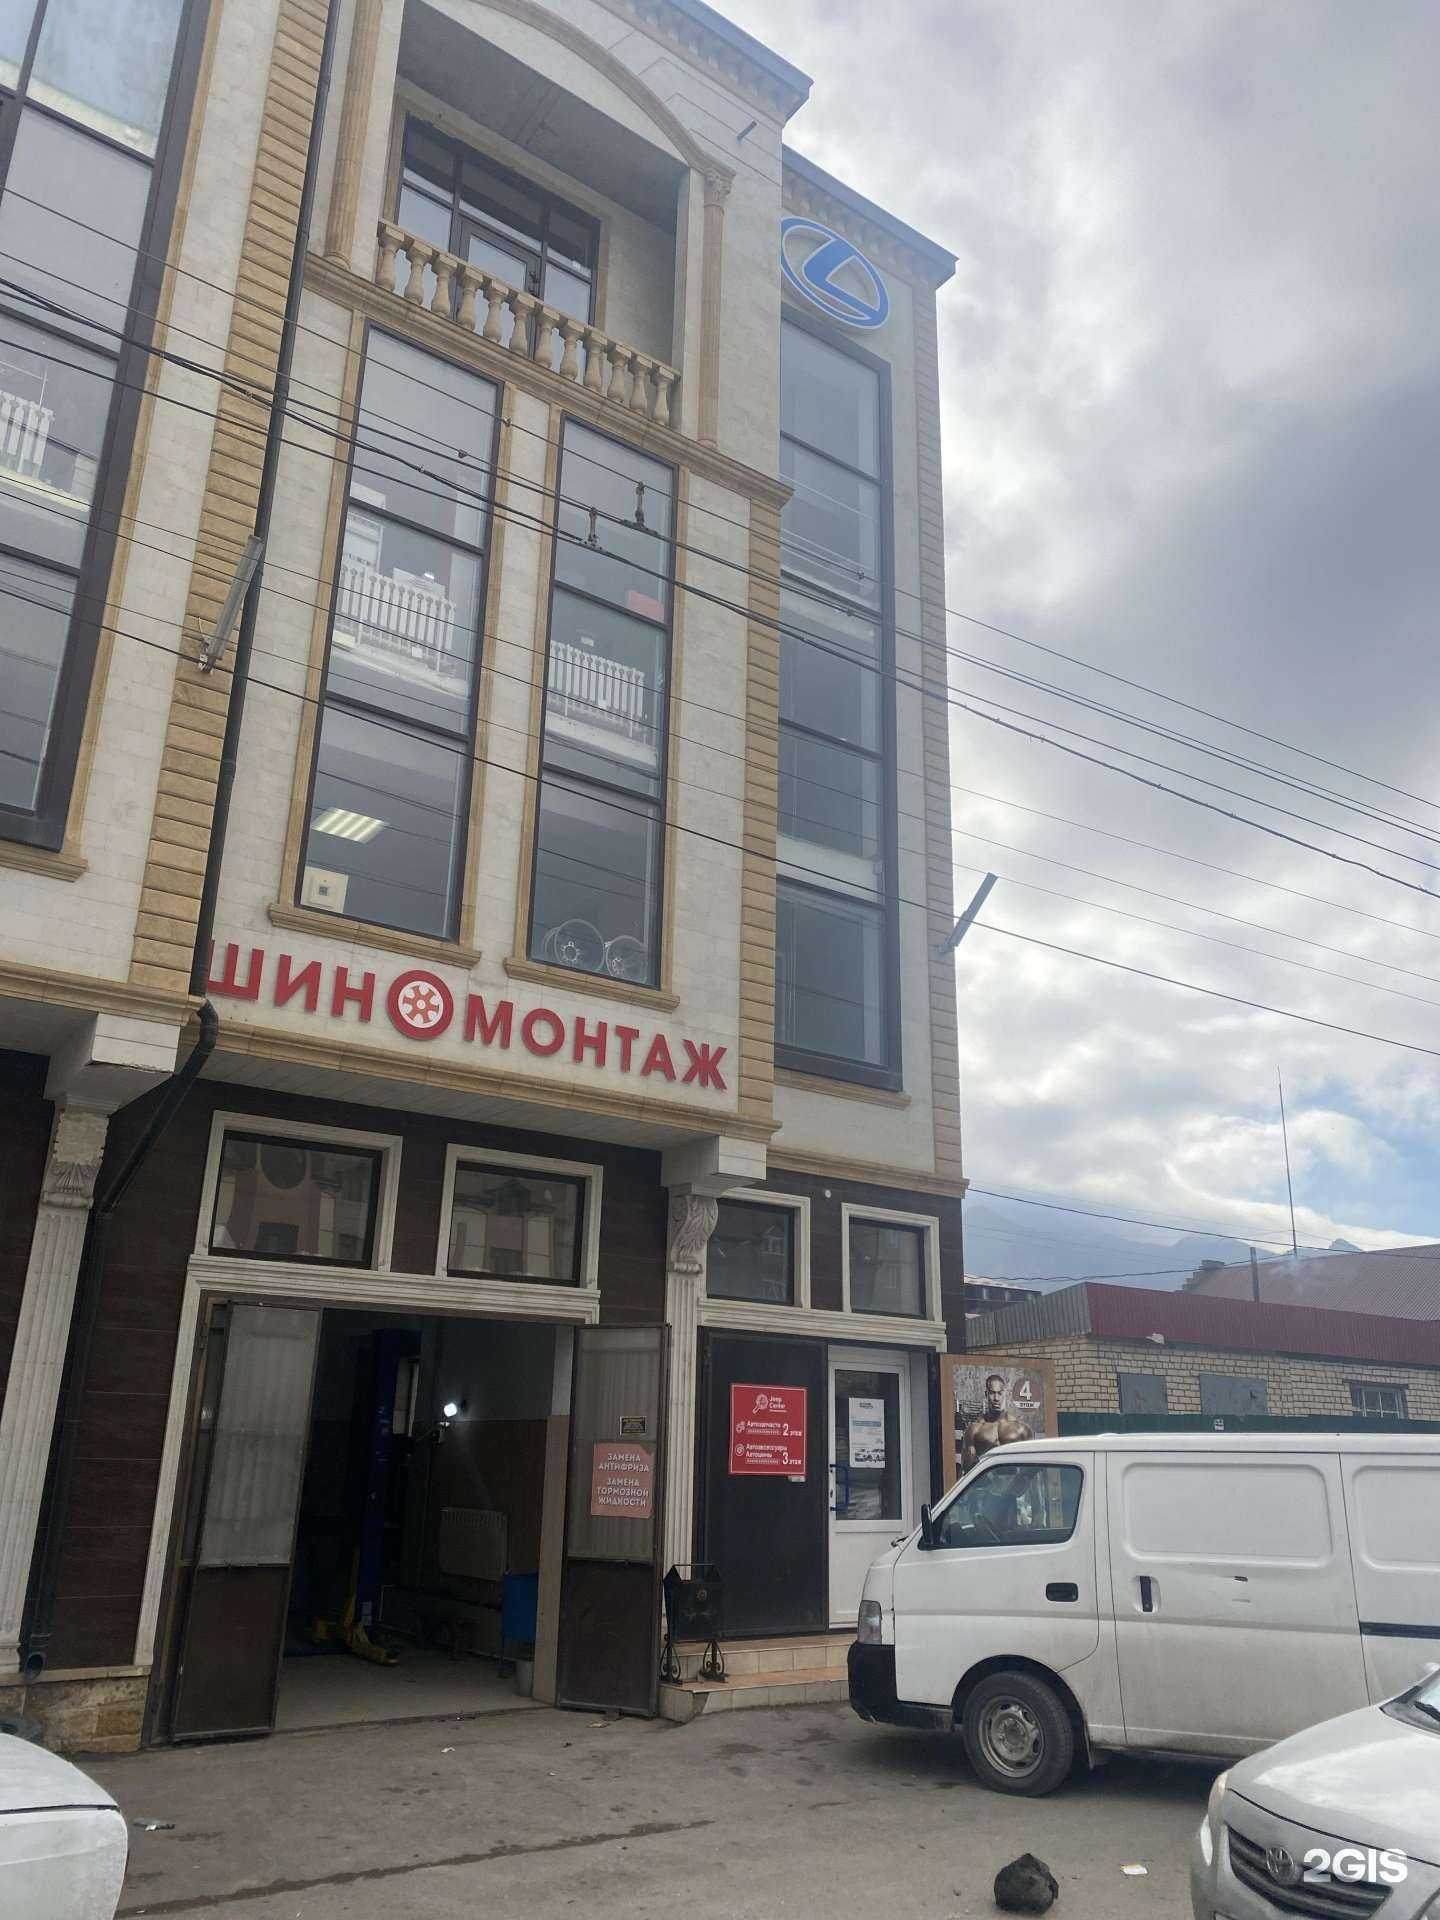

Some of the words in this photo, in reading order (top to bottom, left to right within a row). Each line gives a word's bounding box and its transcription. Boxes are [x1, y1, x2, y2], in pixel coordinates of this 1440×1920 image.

[1019, 1381, 1032, 1401] 4
[783, 1424, 789, 1436] 2
[607, 1453, 641, 1462] ЗАМЕНА
[783, 1452, 789, 1464] 3
[598, 1462, 650, 1473] АНТИФРИЗА
[607, 1477, 640, 1486] ЗАМЕНА
[597, 1486, 649, 1497] ТОРМОЗНОЙ
[598, 1496, 646, 1507] ЖИДКОСТИ
